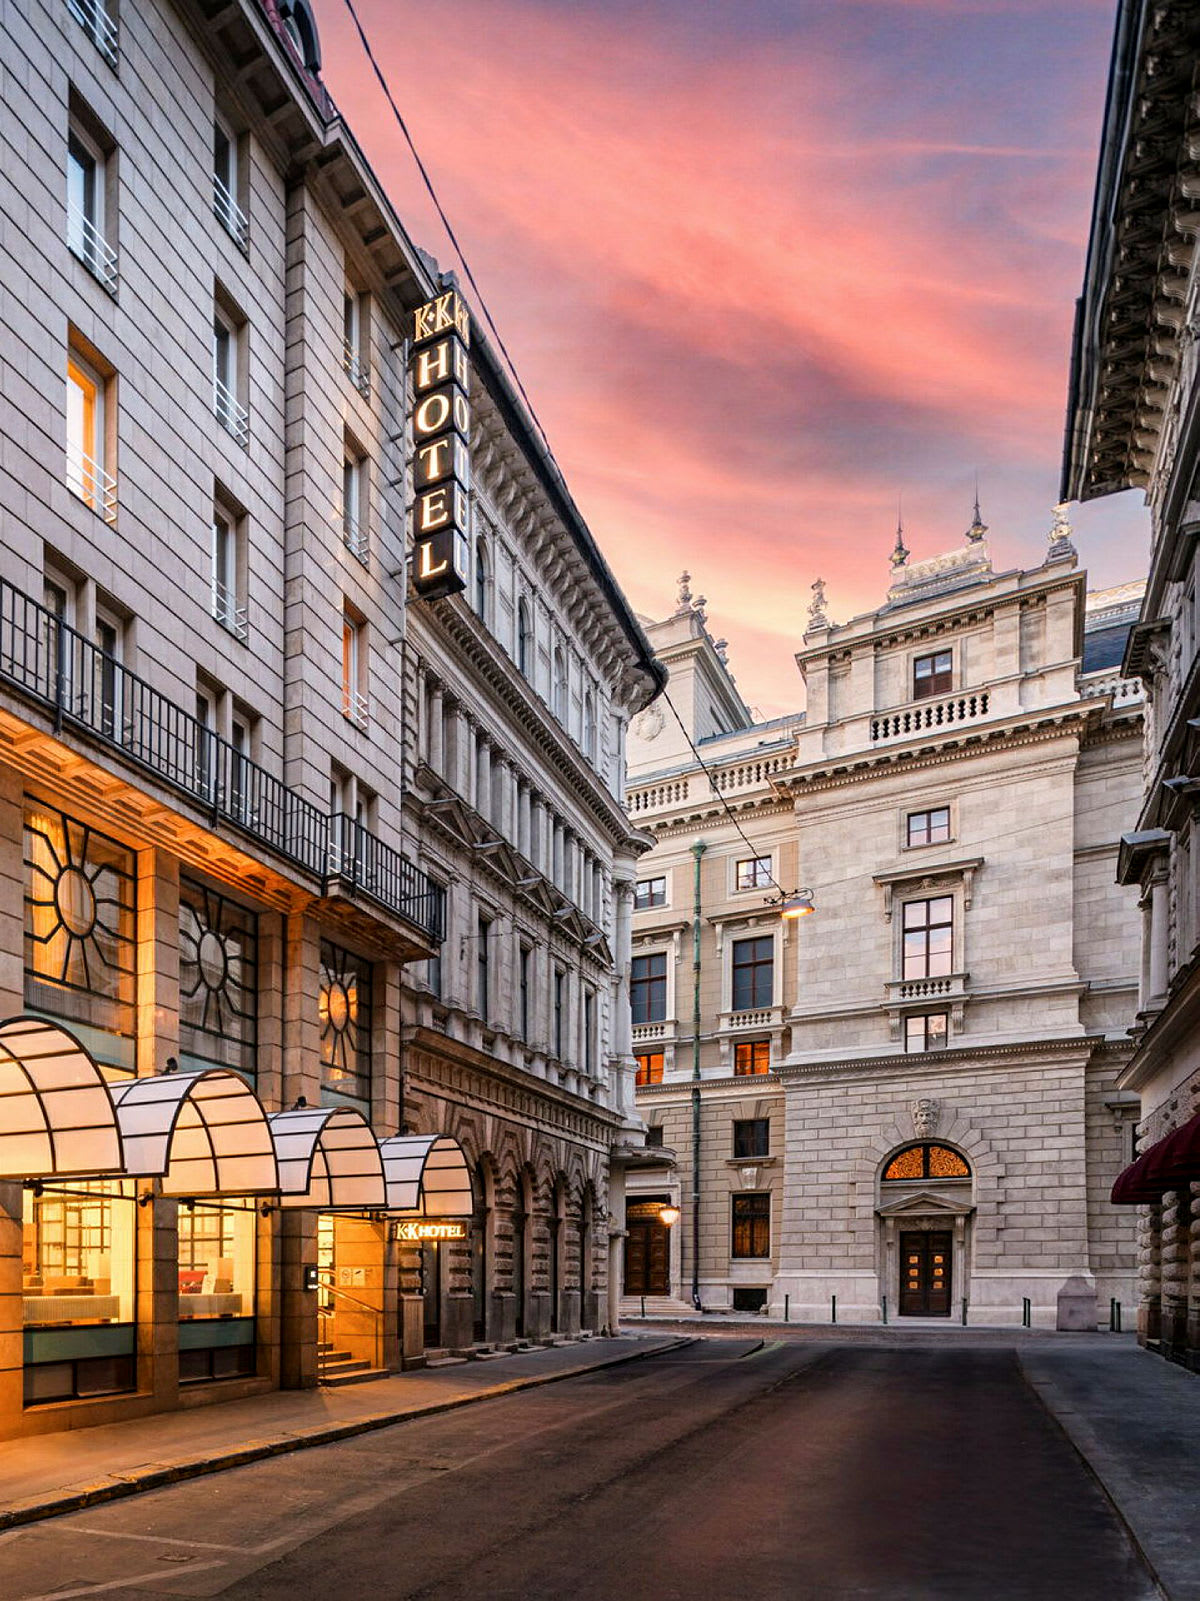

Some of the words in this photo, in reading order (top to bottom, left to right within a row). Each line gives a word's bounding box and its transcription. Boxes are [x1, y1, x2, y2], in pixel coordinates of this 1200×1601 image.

[416, 342, 450, 579] HOTEL
[454, 344, 469, 580] HOTEL
[418, 1225, 466, 1238] HOTEL
